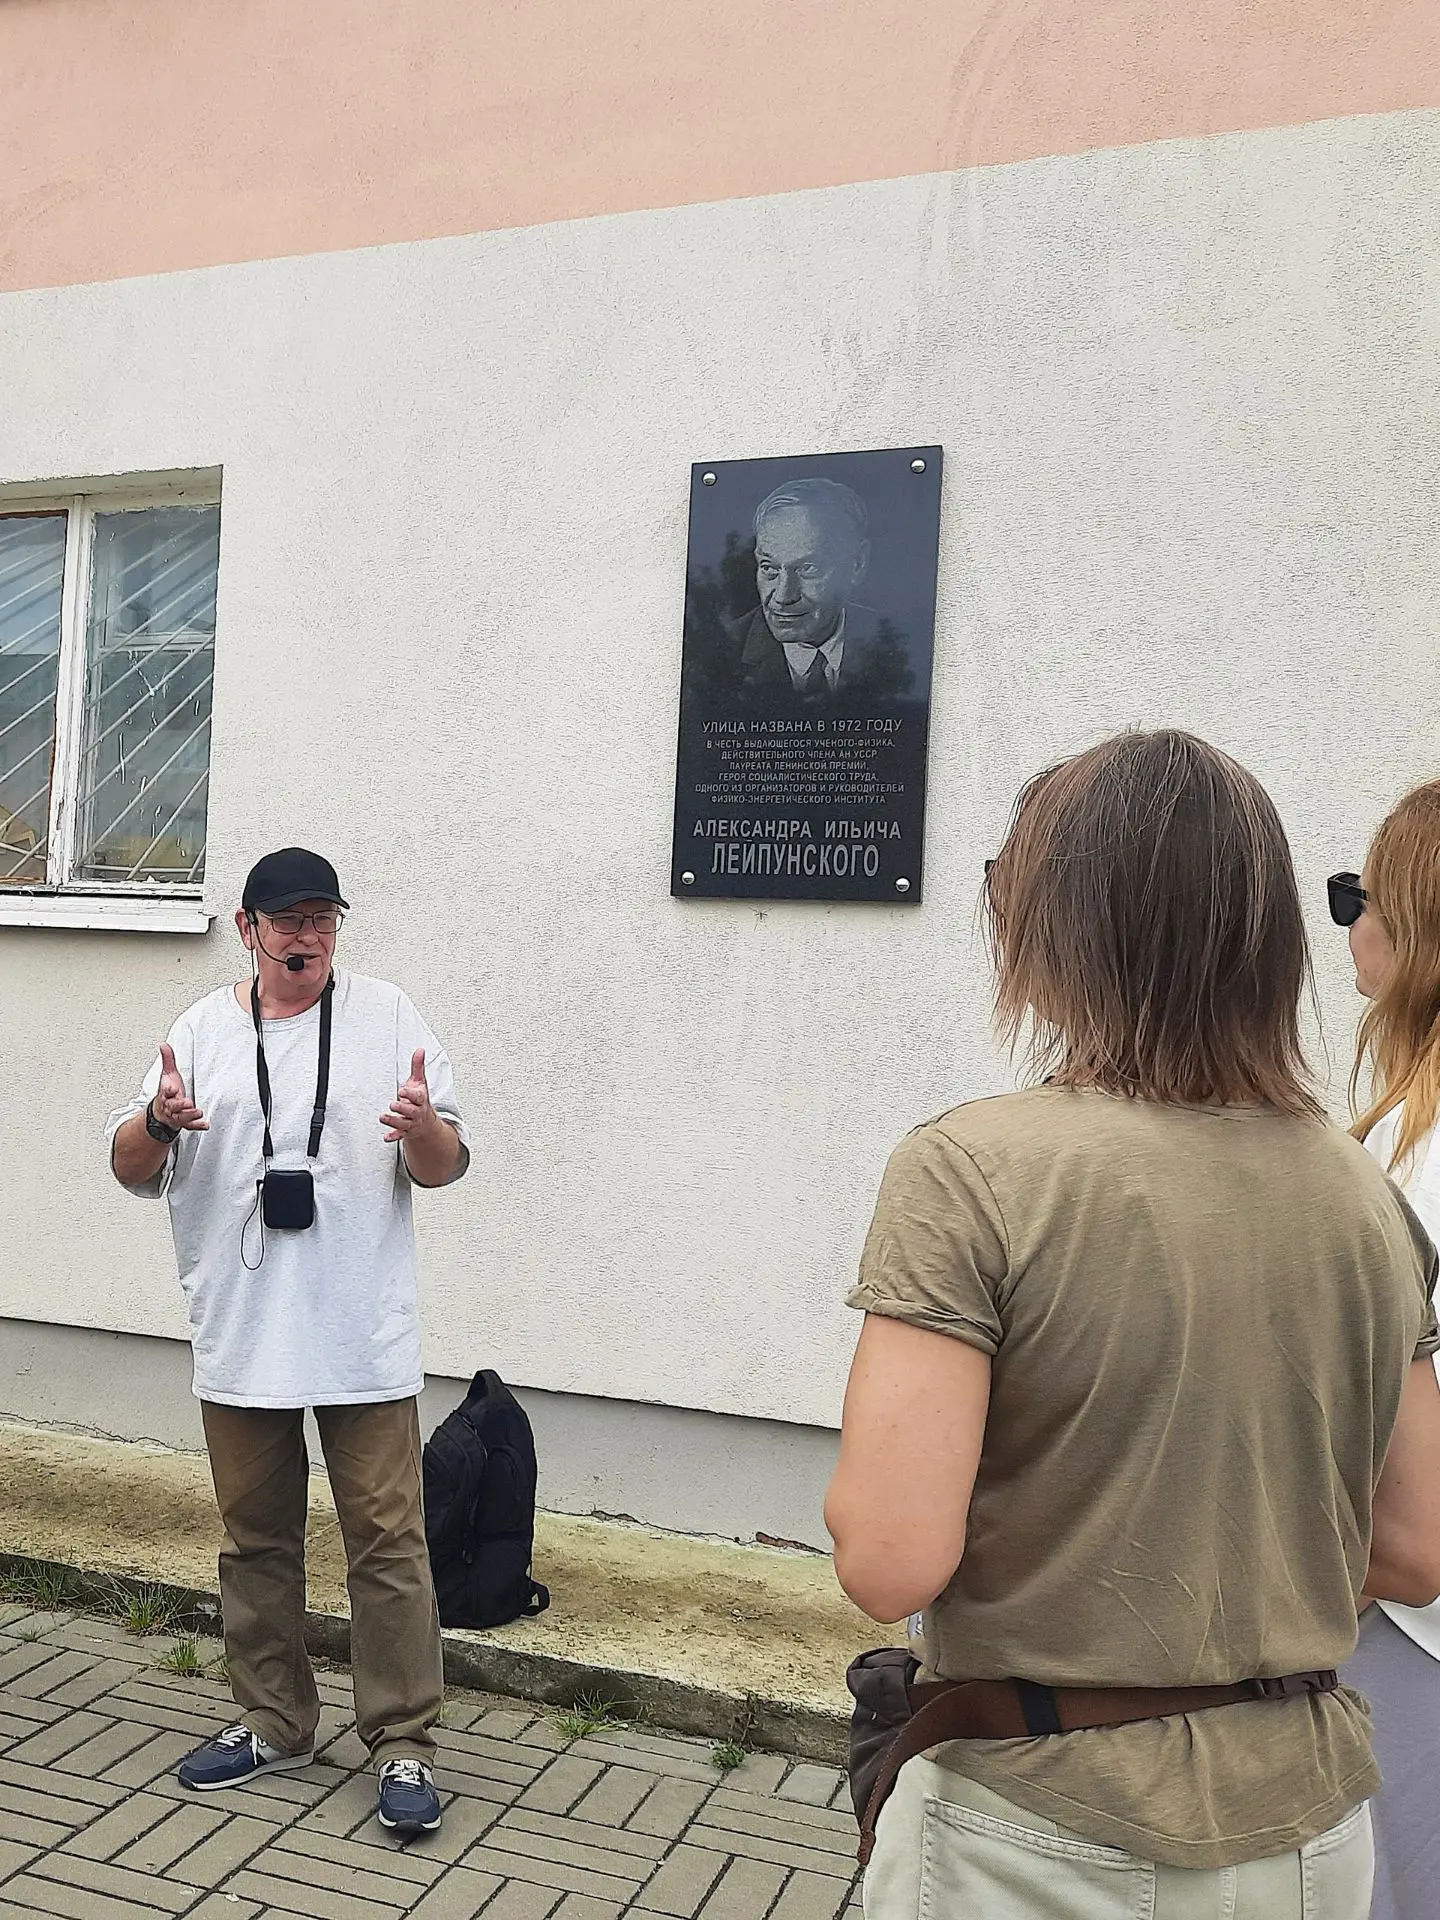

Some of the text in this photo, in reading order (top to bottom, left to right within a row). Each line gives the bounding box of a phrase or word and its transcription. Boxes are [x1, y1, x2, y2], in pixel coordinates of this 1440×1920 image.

[702, 718, 903, 735] УЛИЦА НАЗВАНА В 1972 ГОДУ
[706, 740, 713, 749] В
[714, 739, 742, 749] ЧЕСТЬ
[744, 739, 812, 749] ВЫДАЮЩЕГОСЯ
[721, 749, 805, 760] ДЕЙСТВИТЕЛЬНОГО
[807, 750, 836, 759] ЧЛЕНА
[839, 749, 851, 759] АН
[729, 761, 771, 770] ЛАУРЕАТА
[774, 760, 827, 770] ЛЕНИНСКОЙ
[718, 772, 746, 781] ГЕРОЯ
[748, 772, 847, 782] СОЦИАЛИСТИЧЕСКОГО
[695, 782, 905, 793] ОДНОГО ИЗ ОРГАНИЗАТОРОВ И РУКОВОДИТЕЛЕЙ
[711, 794, 886, 804] ФИЗИКО-ЭНЕРГЕТИЧЕСКОГО ИНСТИТУТА
[693, 819, 902, 840] АЛЕКСАНДРА ИЛЬИЧА
[711, 839, 880, 877] ЛЕЙПУНСКОГО
